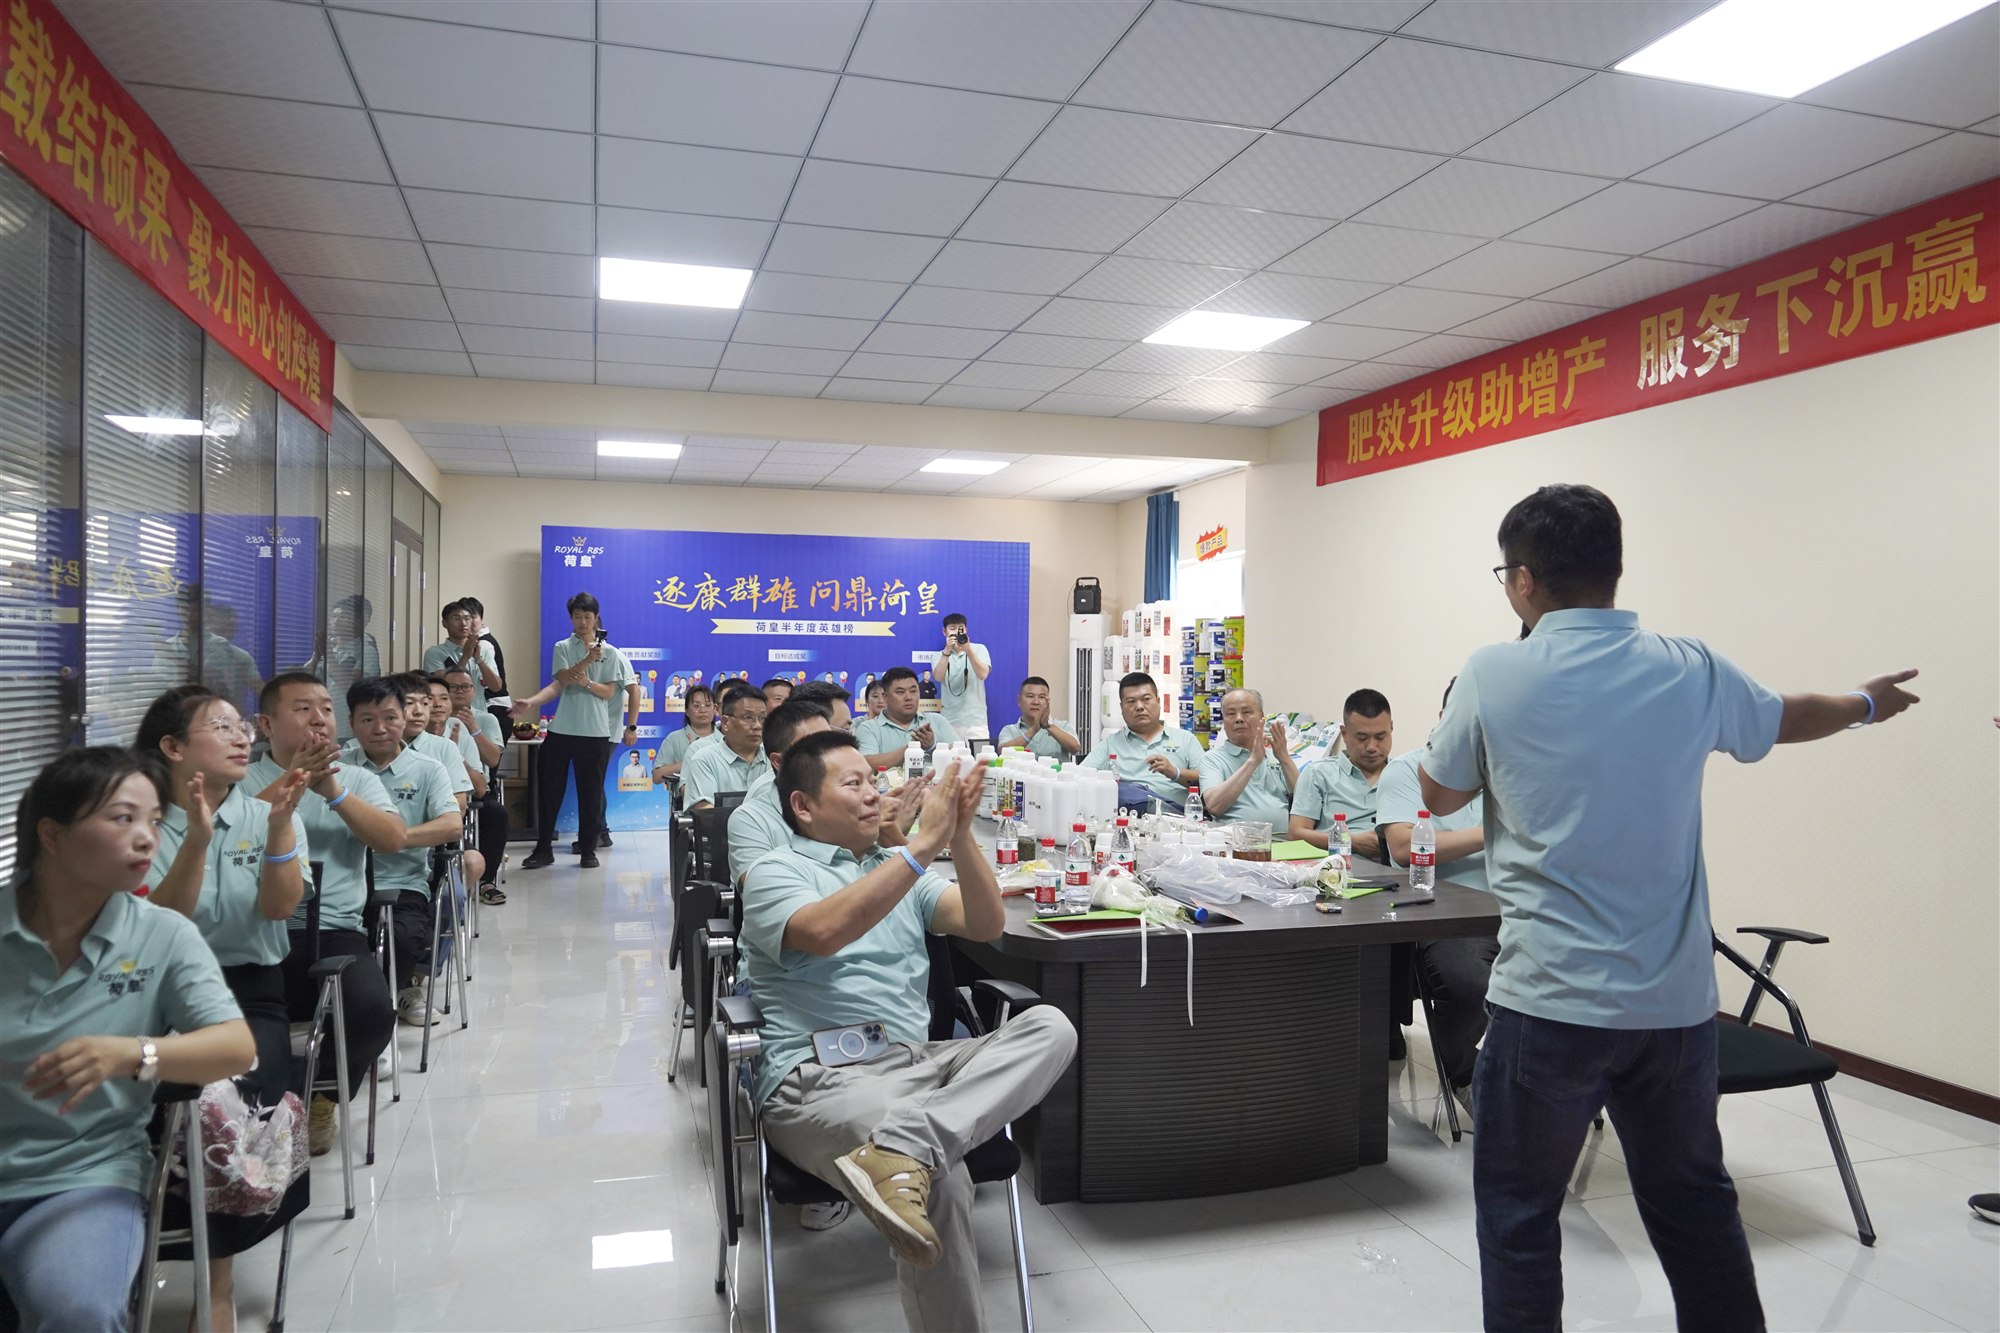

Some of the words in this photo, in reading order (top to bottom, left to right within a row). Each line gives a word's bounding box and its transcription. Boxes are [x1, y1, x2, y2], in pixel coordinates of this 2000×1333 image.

[0, 0, 172, 266] 载结硕果
[187, 197, 321, 407] 聚力同心创辉煌
[1346, 335, 1607, 465] 肥效升级助增产
[1636, 211, 1987, 390] 服务下沉赢
[554, 545, 584, 554] ROYAL
[586, 546, 605, 555] RBS
[563, 555, 593, 568] 荷皇
[809, 575, 940, 617] 问鼎荷皇
[755, 621, 854, 634] 荷皇半年度英雄榜
